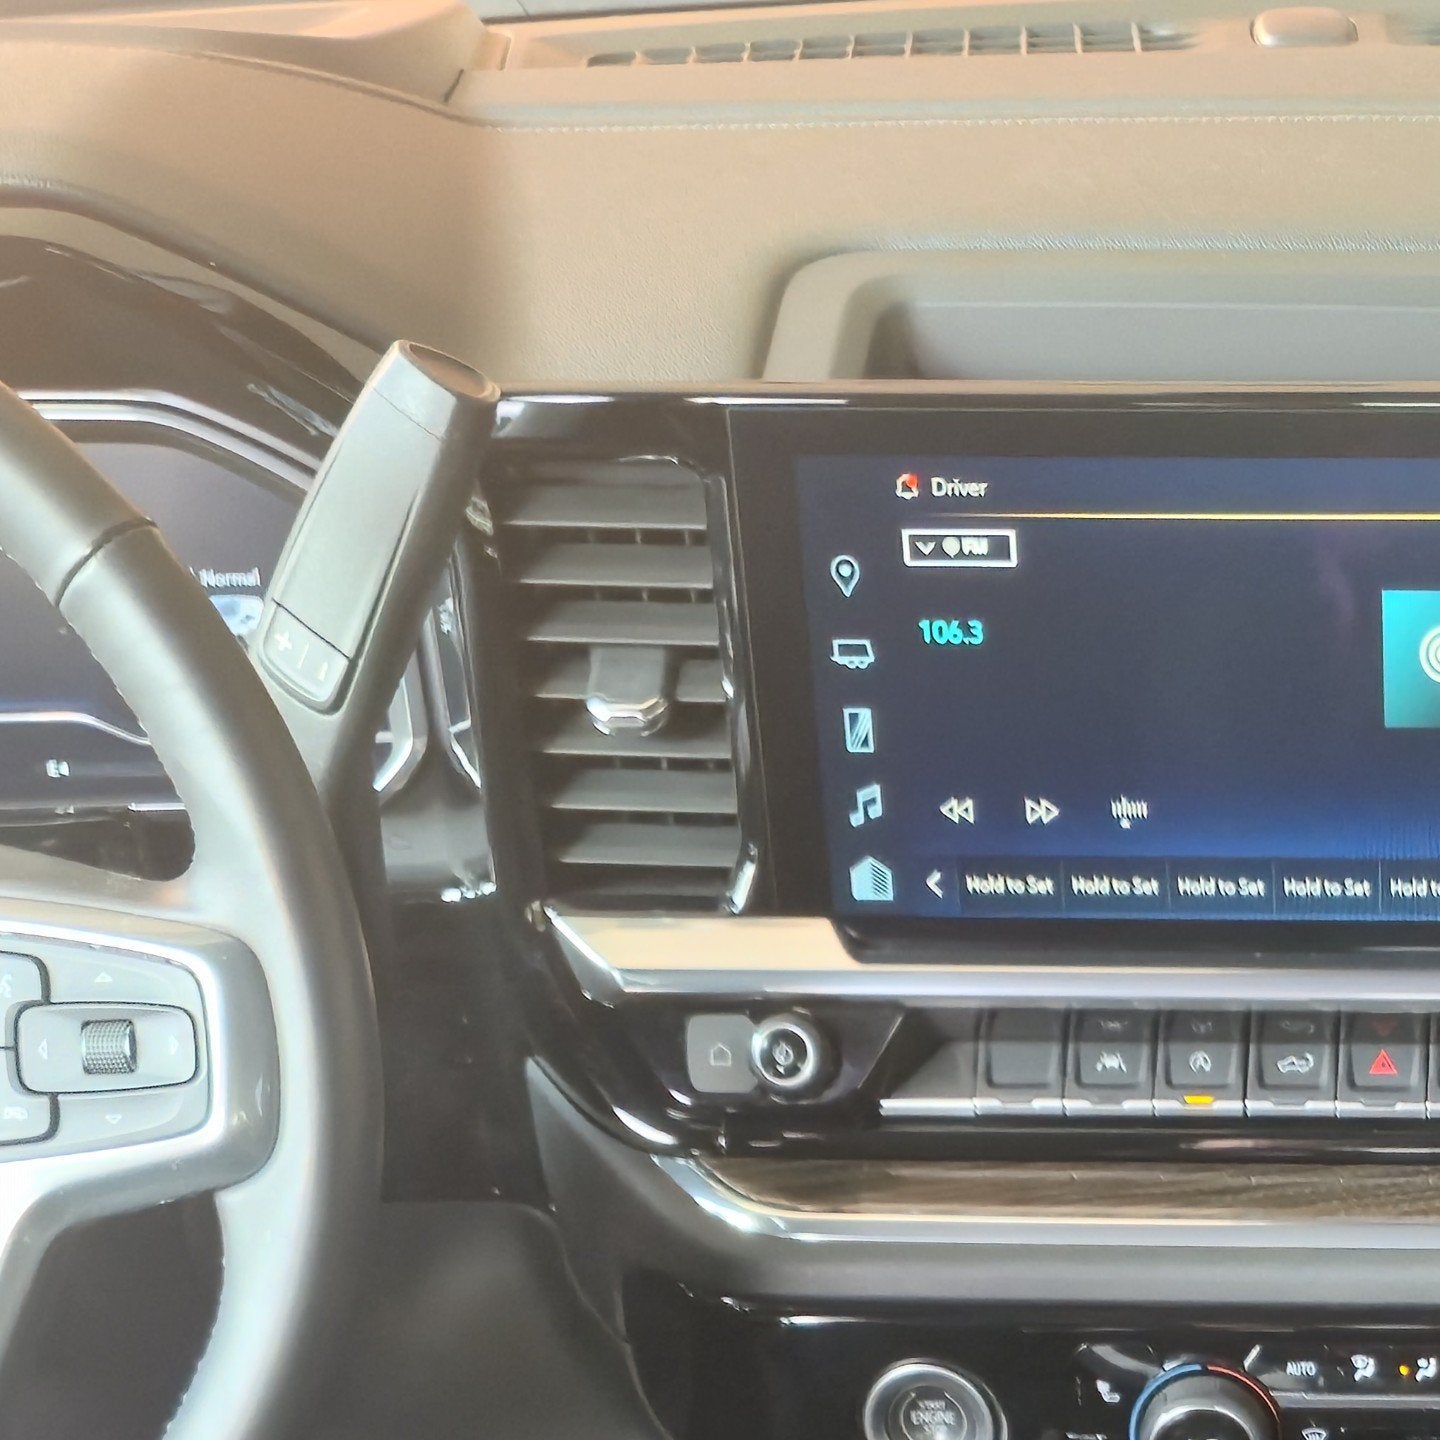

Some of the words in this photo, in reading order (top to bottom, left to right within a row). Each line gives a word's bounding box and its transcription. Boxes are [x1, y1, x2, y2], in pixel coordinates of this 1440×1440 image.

[931, 477, 988, 498] Driver
[199, 567, 260, 588] Normal
[918, 619, 984, 645] 106.3
[965, 873, 1005, 895] Hold
[1006, 876, 1025, 895] to
[1026, 874, 1054, 895] Set
[1071, 874, 1110, 896] Hold
[1111, 877, 1130, 896] to
[1131, 875, 1159, 896] Set
[1177, 876, 1216, 897] Hold
[1218, 879, 1236, 897] to
[1238, 877, 1265, 897] Set
[1283, 876, 1321, 898] Hold
[1324, 879, 1342, 898] to
[1344, 877, 1371, 898] Set
[1390, 877, 1428, 898] Hold
[1286, 1361, 1317, 1376] AUTO
